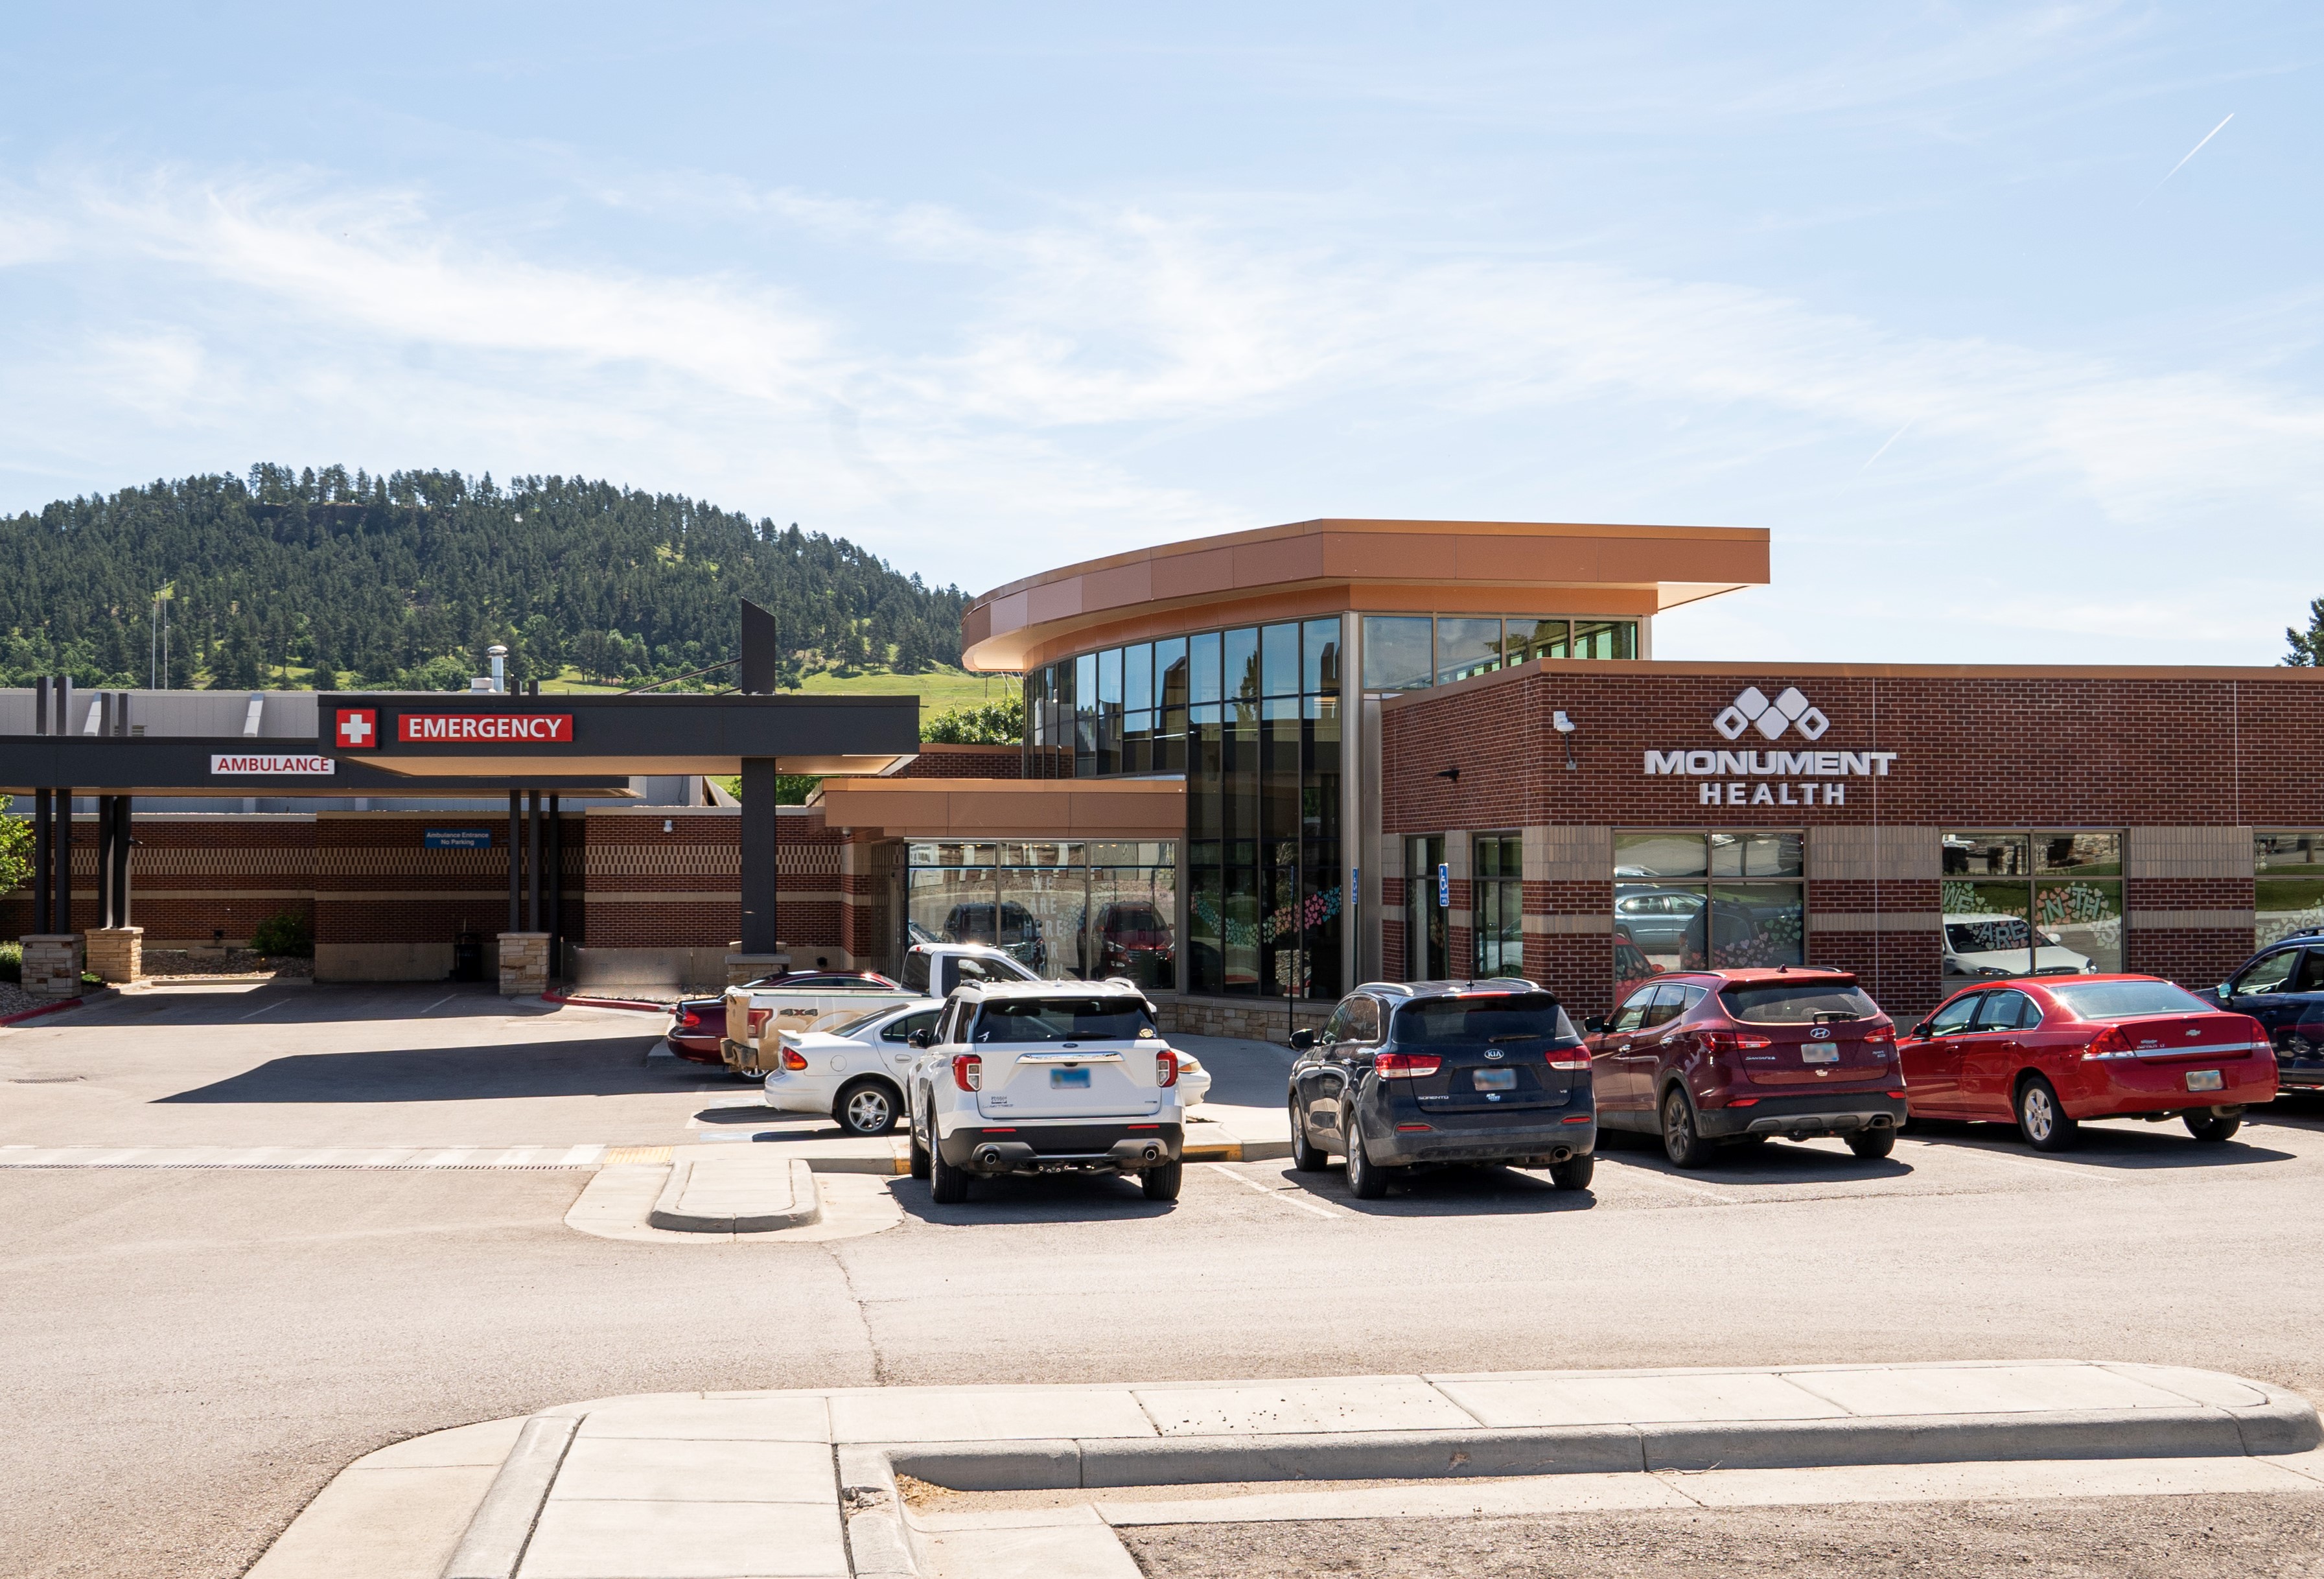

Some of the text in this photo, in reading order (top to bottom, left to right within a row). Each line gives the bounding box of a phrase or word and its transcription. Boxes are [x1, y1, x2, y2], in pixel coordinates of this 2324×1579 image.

[410, 718, 563, 738] EMERGENCY
[218, 758, 329, 772] AMBULANCE
[1644, 751, 1898, 775] MONUMENT
[1699, 783, 1844, 805] HEALTH
[1030, 897, 1057, 914] ARE
[1943, 883, 2117, 949] WE ARE IN THIS
[1023, 920, 1063, 937] HERE
[1030, 942, 1058, 959] FOR
